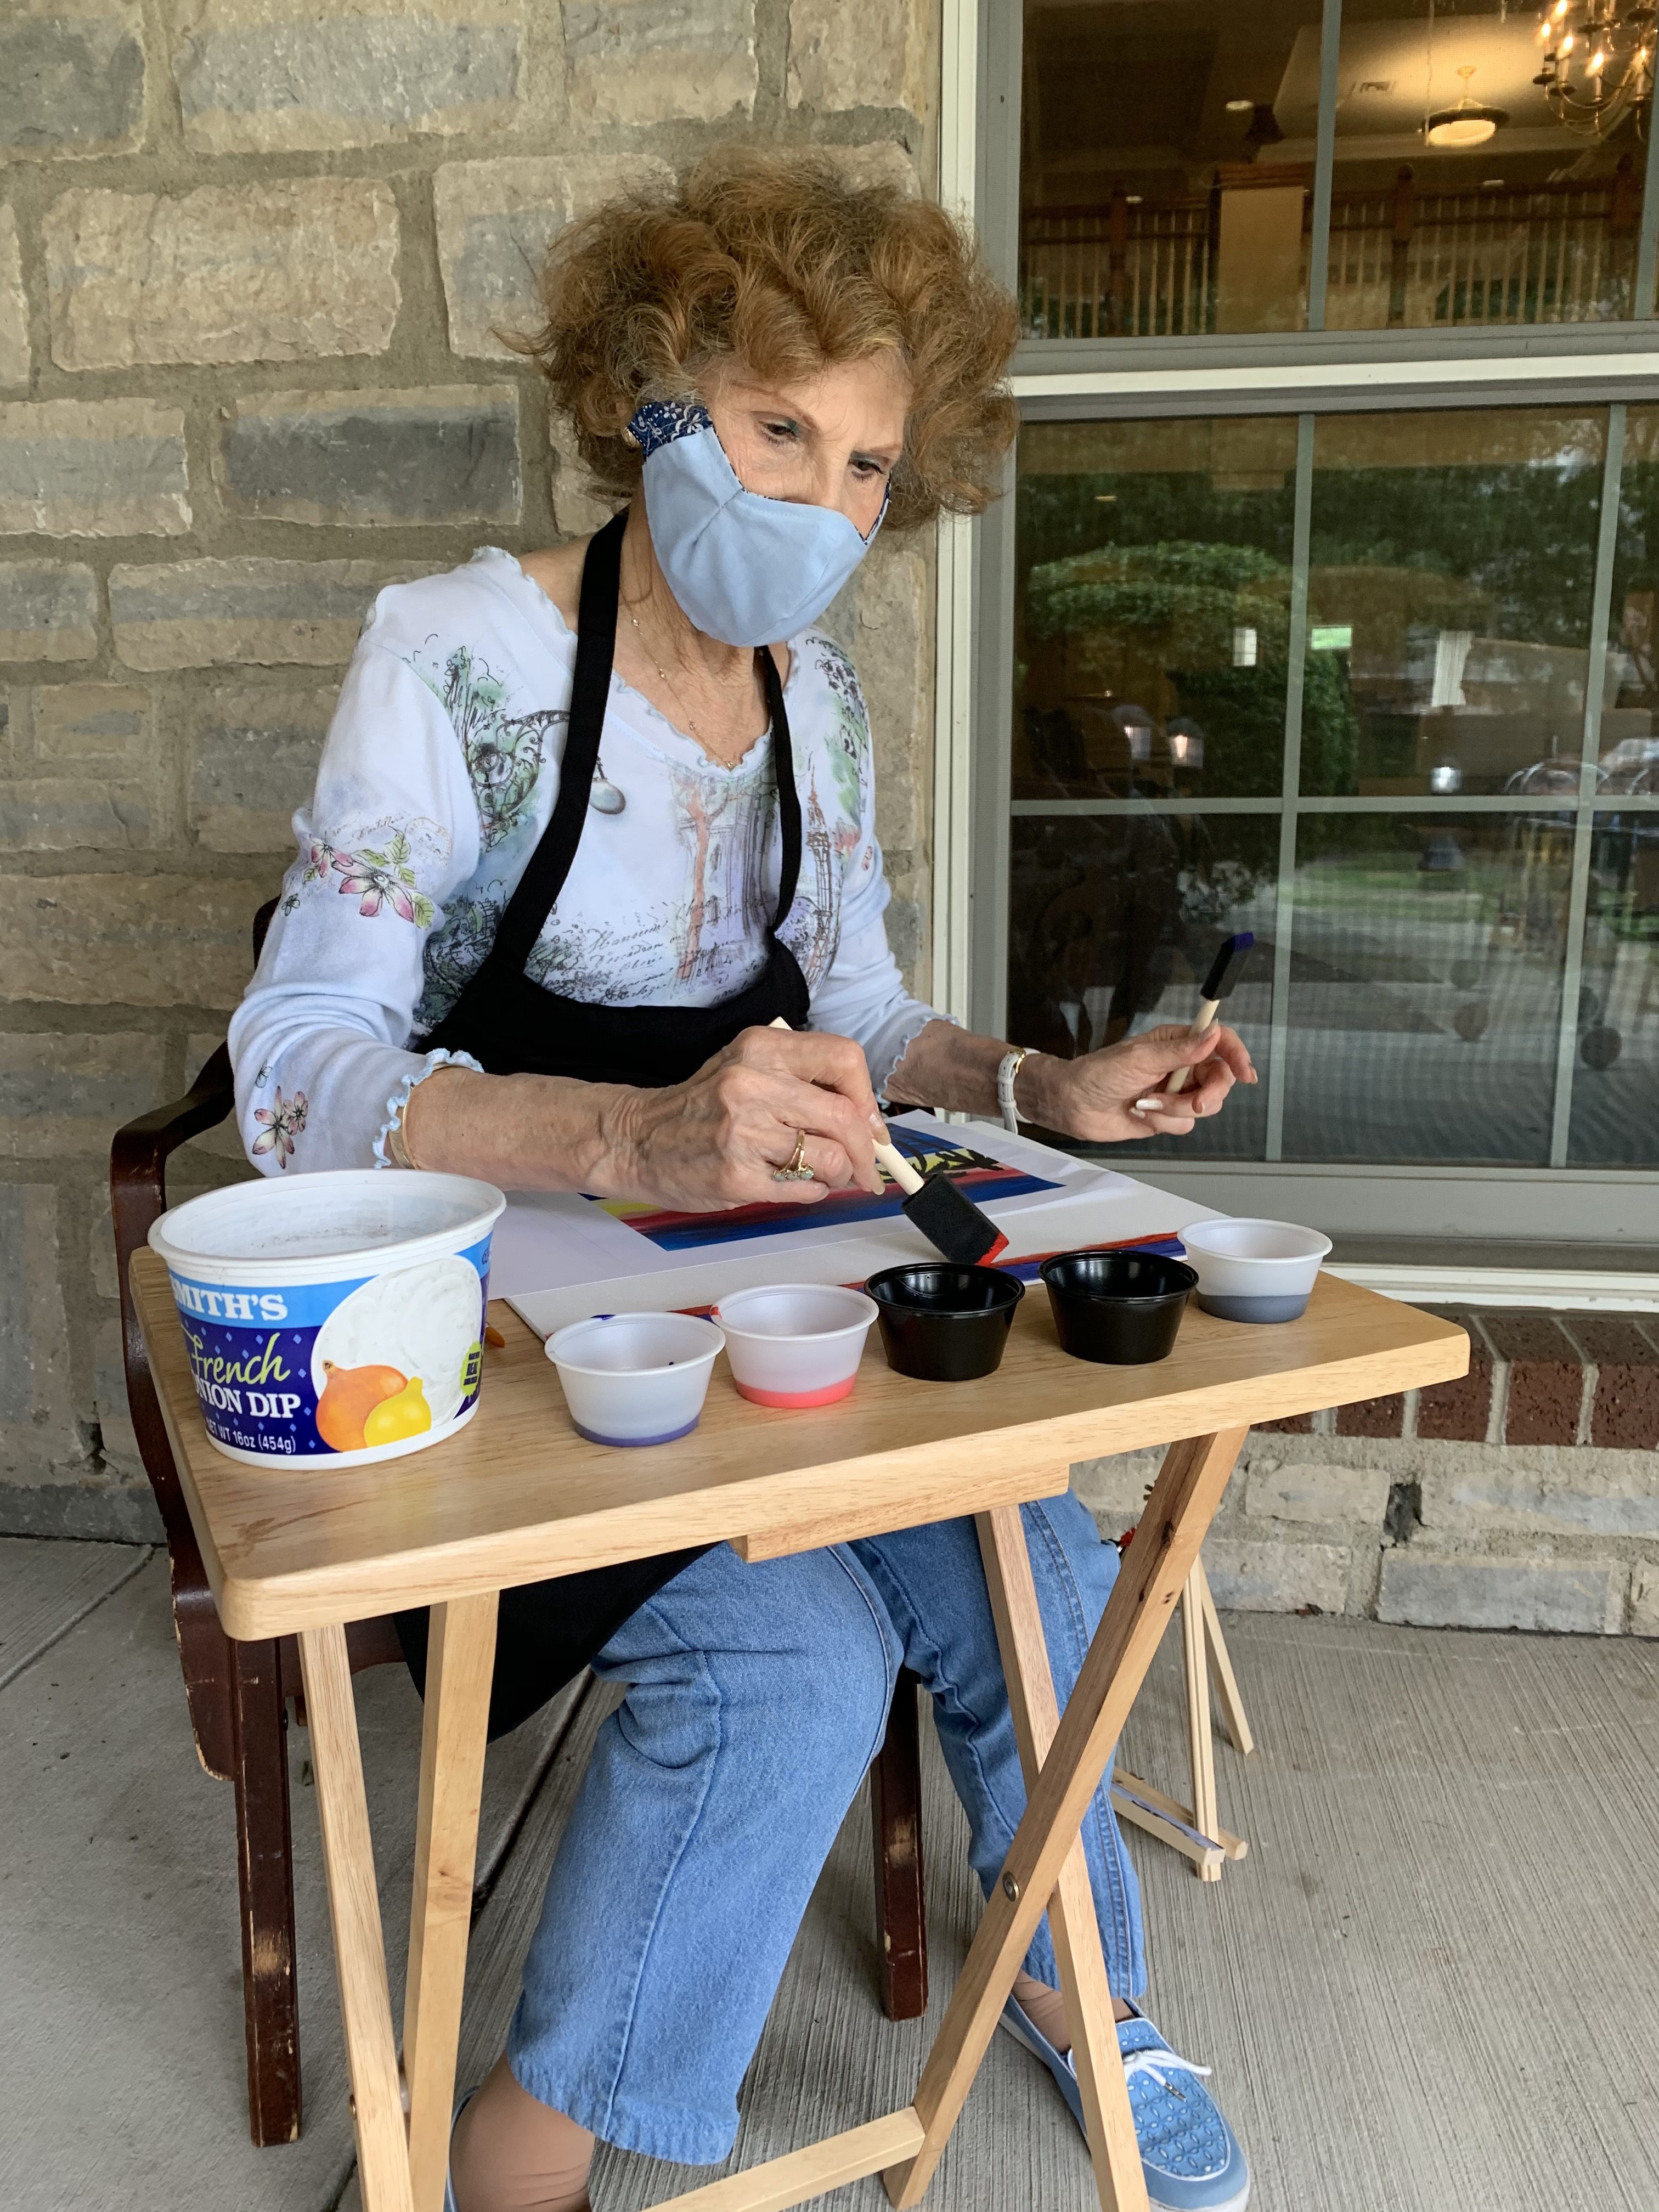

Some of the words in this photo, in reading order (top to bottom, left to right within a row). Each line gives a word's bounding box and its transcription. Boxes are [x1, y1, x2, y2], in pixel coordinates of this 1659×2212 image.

[246, 1391, 301, 1419] DIP
[218, 1424, 231, 1442] WT
[232, 1429, 256, 1448] 16oz
[258, 1433, 296, 1454] (454g)
